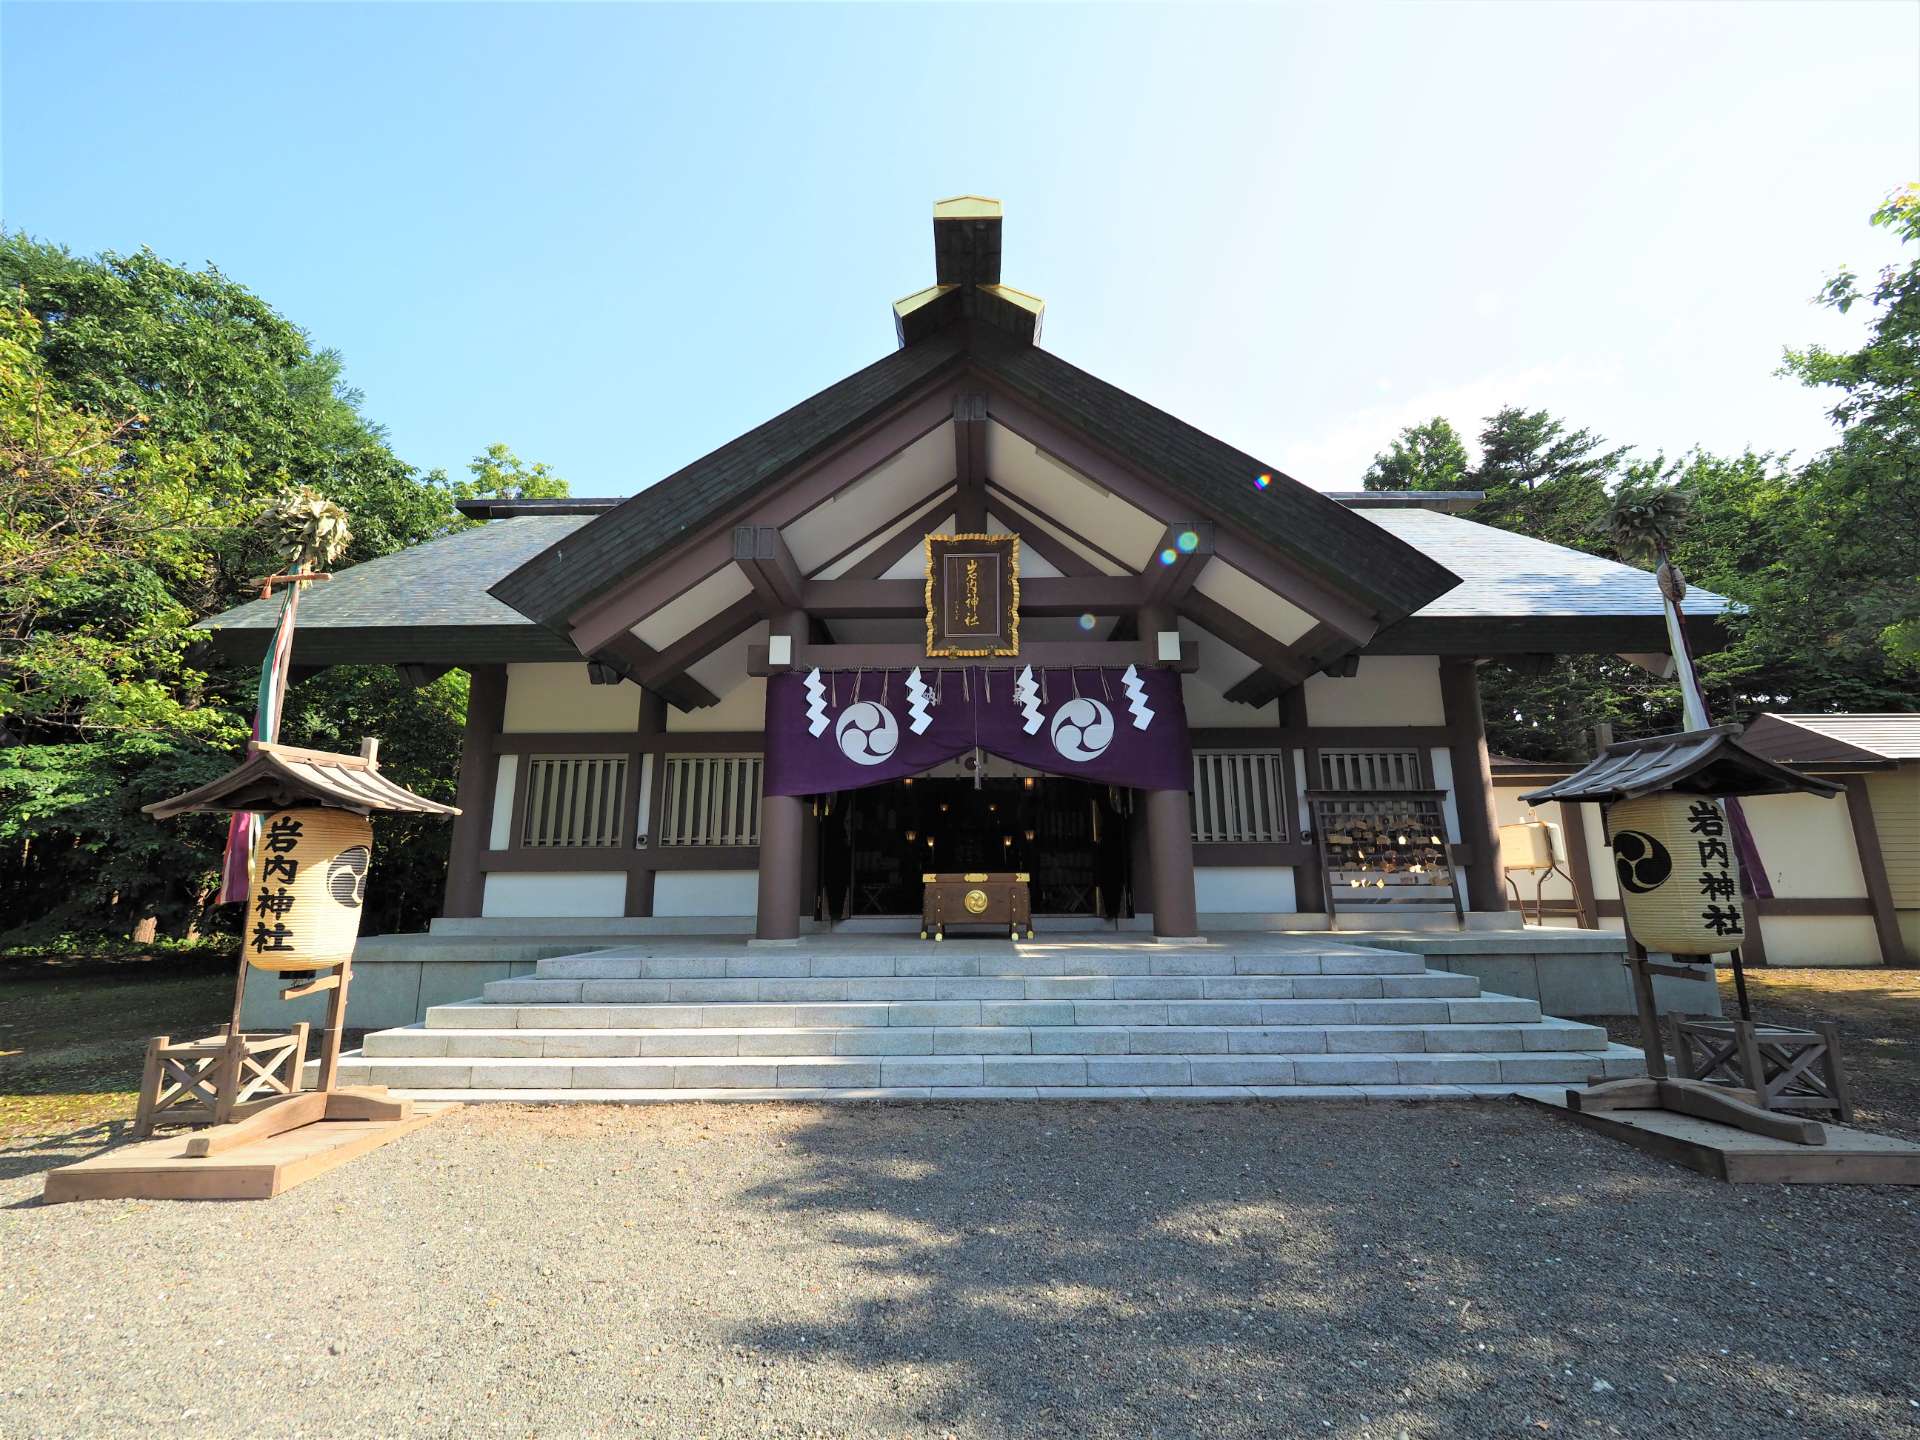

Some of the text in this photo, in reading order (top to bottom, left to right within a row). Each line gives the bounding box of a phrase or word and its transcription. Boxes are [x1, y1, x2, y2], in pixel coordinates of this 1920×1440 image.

[252, 816, 303, 954] 岩内神社
[1688, 800, 1743, 936] 岩内神社
